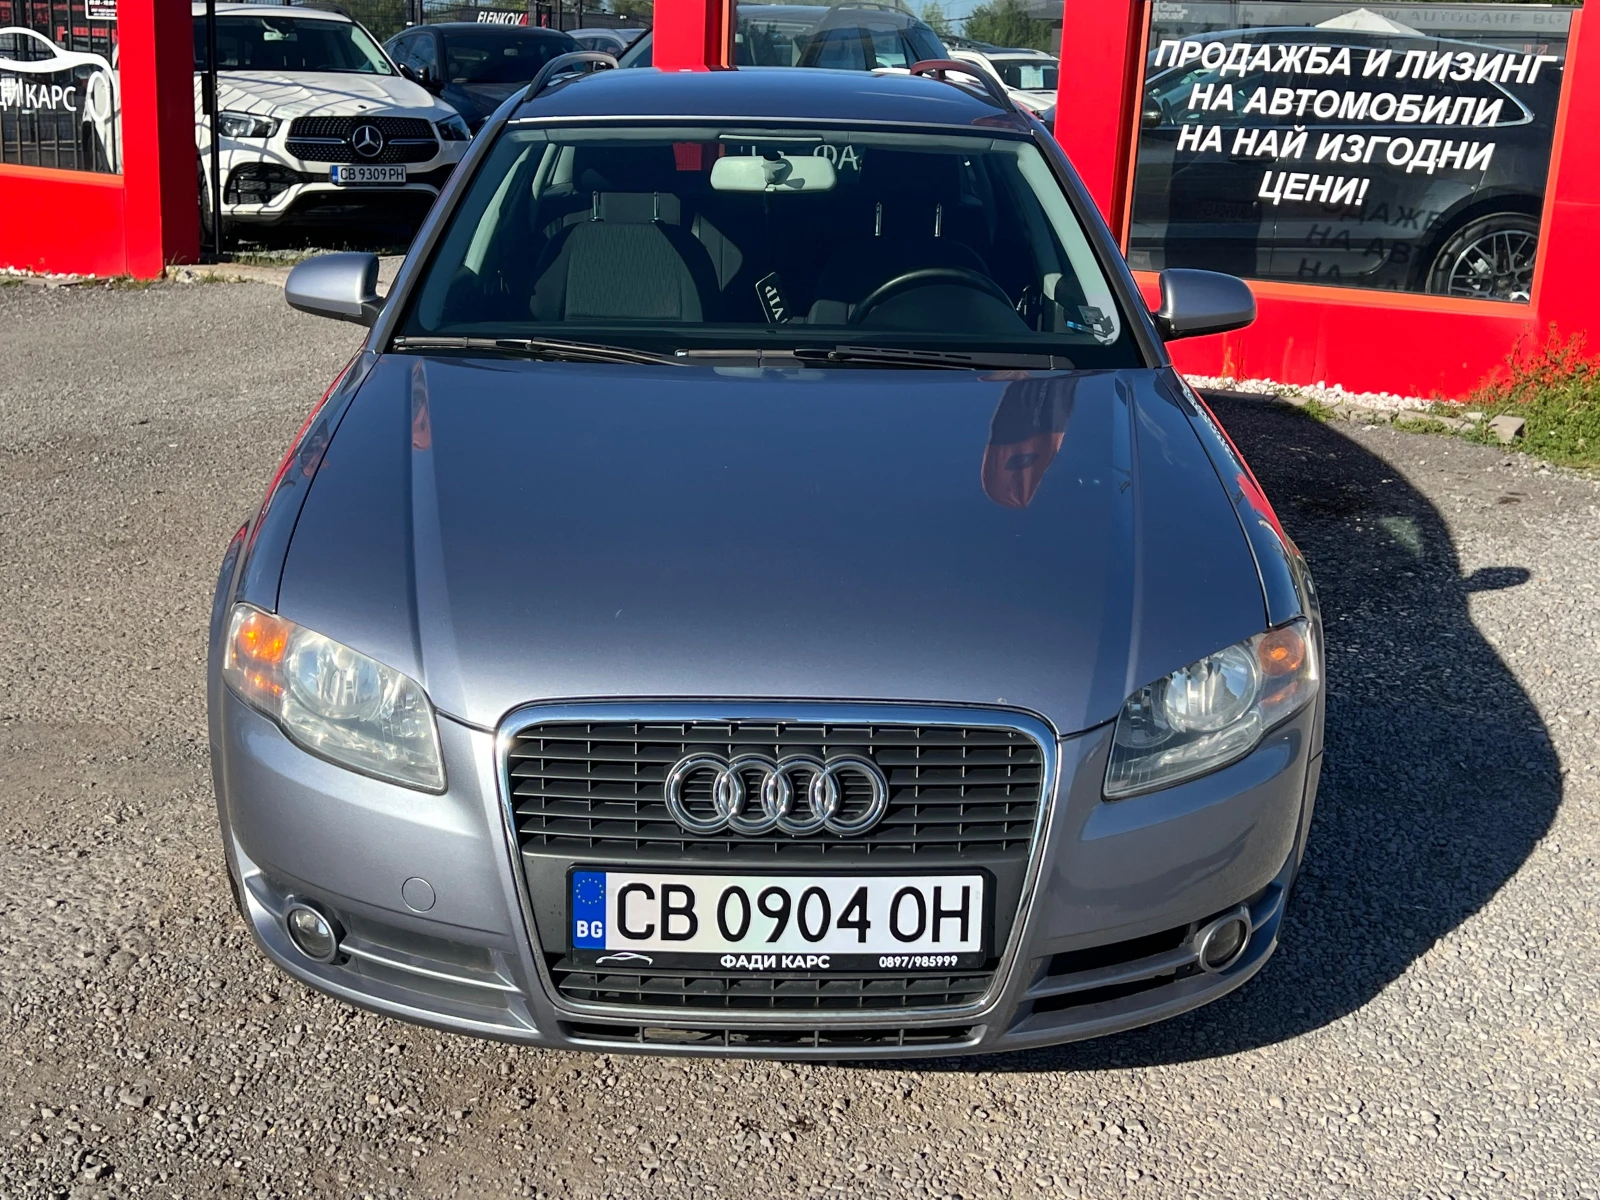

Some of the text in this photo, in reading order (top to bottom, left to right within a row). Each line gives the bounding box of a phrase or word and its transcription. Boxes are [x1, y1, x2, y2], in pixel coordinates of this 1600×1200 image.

[1155, 40, 1559, 84] ПРОДАЖБА И ЛИЗИНГ
[25, 84, 77, 111] КАРС
[1188, 84, 1504, 127] НА АВТОМОБИЛИ
[1177, 125, 1496, 174] НА НАЙ ИЗГОДНИ
[340, 168, 356, 180] CB
[358, 168, 387, 180] 9309
[388, 168, 404, 180] PH
[1259, 171, 1370, 206] ЦЕНИ!
[765, 286, 784, 321] VIP
[576, 920, 603, 939] BG
[616, 882, 970, 944] CB 0904 OH
[720, 953, 958, 970] ФАДИ КАРС 0897/985999
